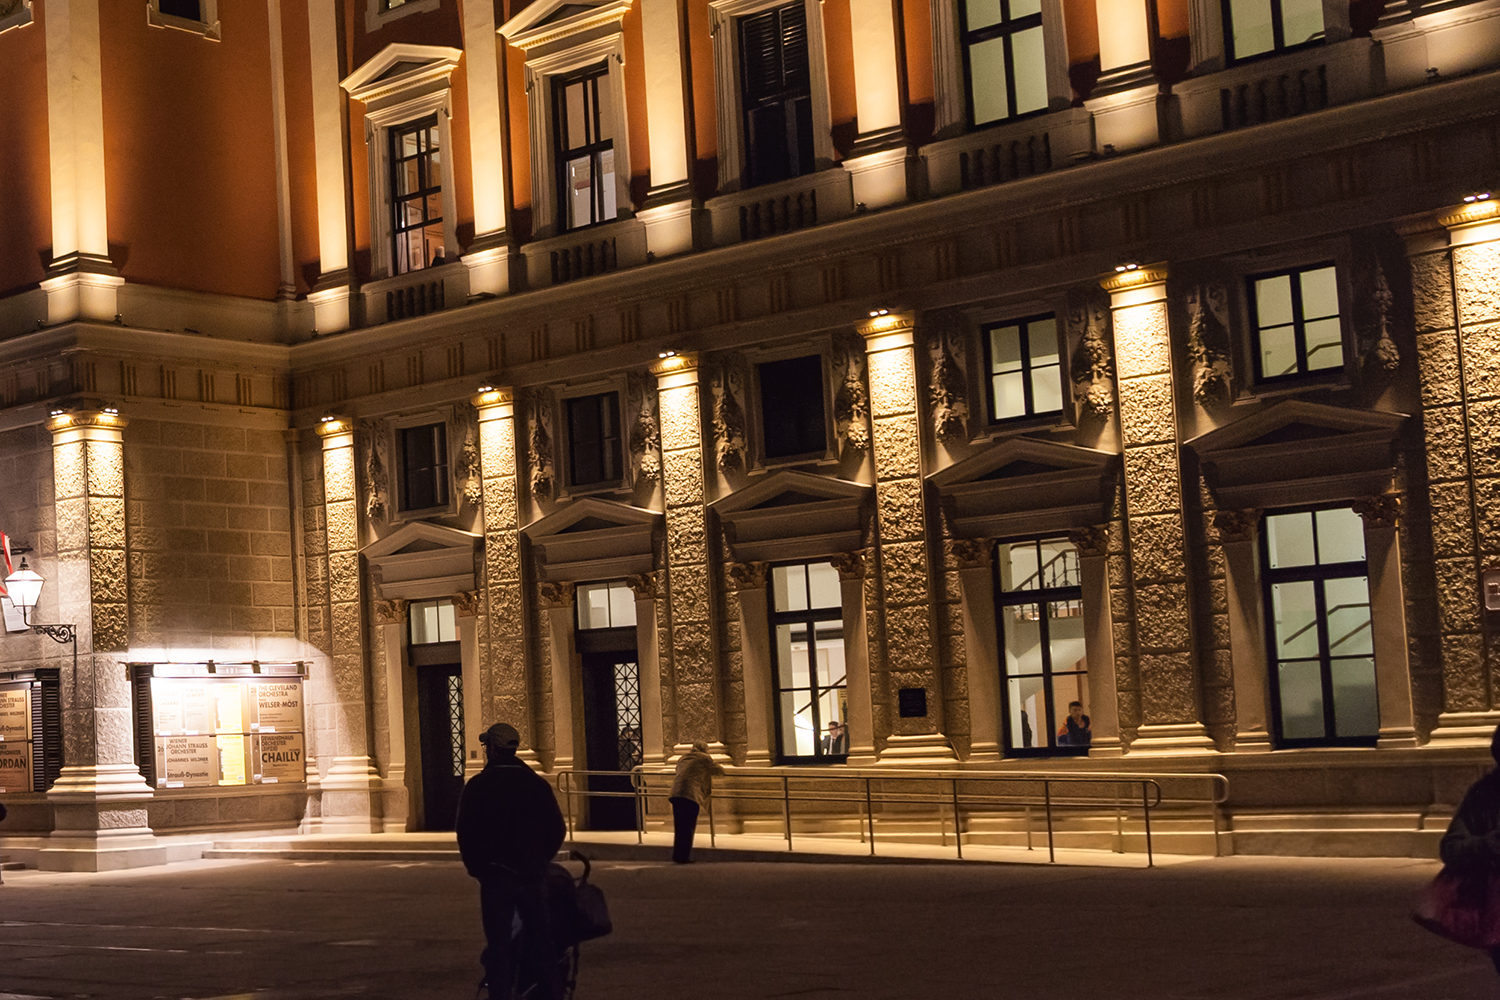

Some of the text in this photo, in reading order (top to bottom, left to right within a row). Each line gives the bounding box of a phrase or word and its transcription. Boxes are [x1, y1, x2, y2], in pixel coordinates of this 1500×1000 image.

[259, 699, 299, 709] WELSER-MÖST
[157, 745, 165, 753] 26
[261, 751, 301, 763] CHAILLY
